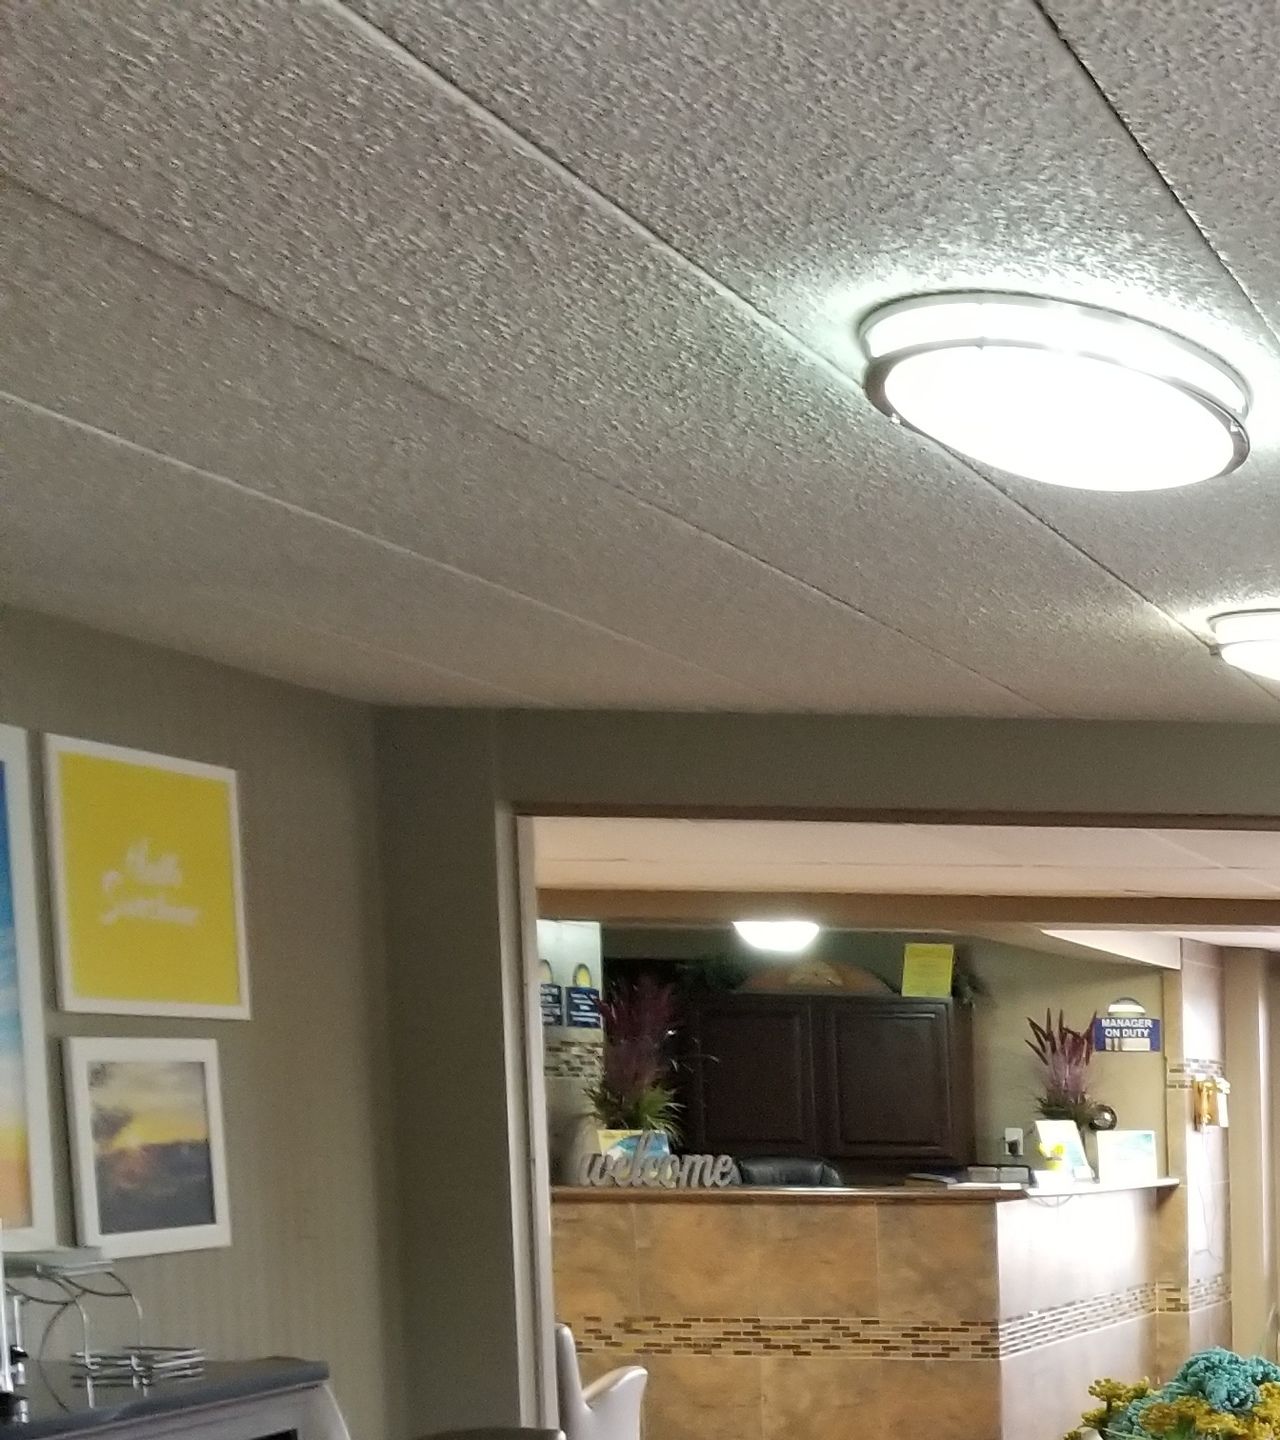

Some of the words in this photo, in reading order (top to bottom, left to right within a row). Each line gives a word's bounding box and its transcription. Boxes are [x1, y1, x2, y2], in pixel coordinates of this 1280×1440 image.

[1101, 1018, 1153, 1028] MANAGER
[1104, 1028, 1120, 1037] ON
[1122, 1028, 1150, 1037] DUTY
[578, 1128, 738, 1189] welcome
